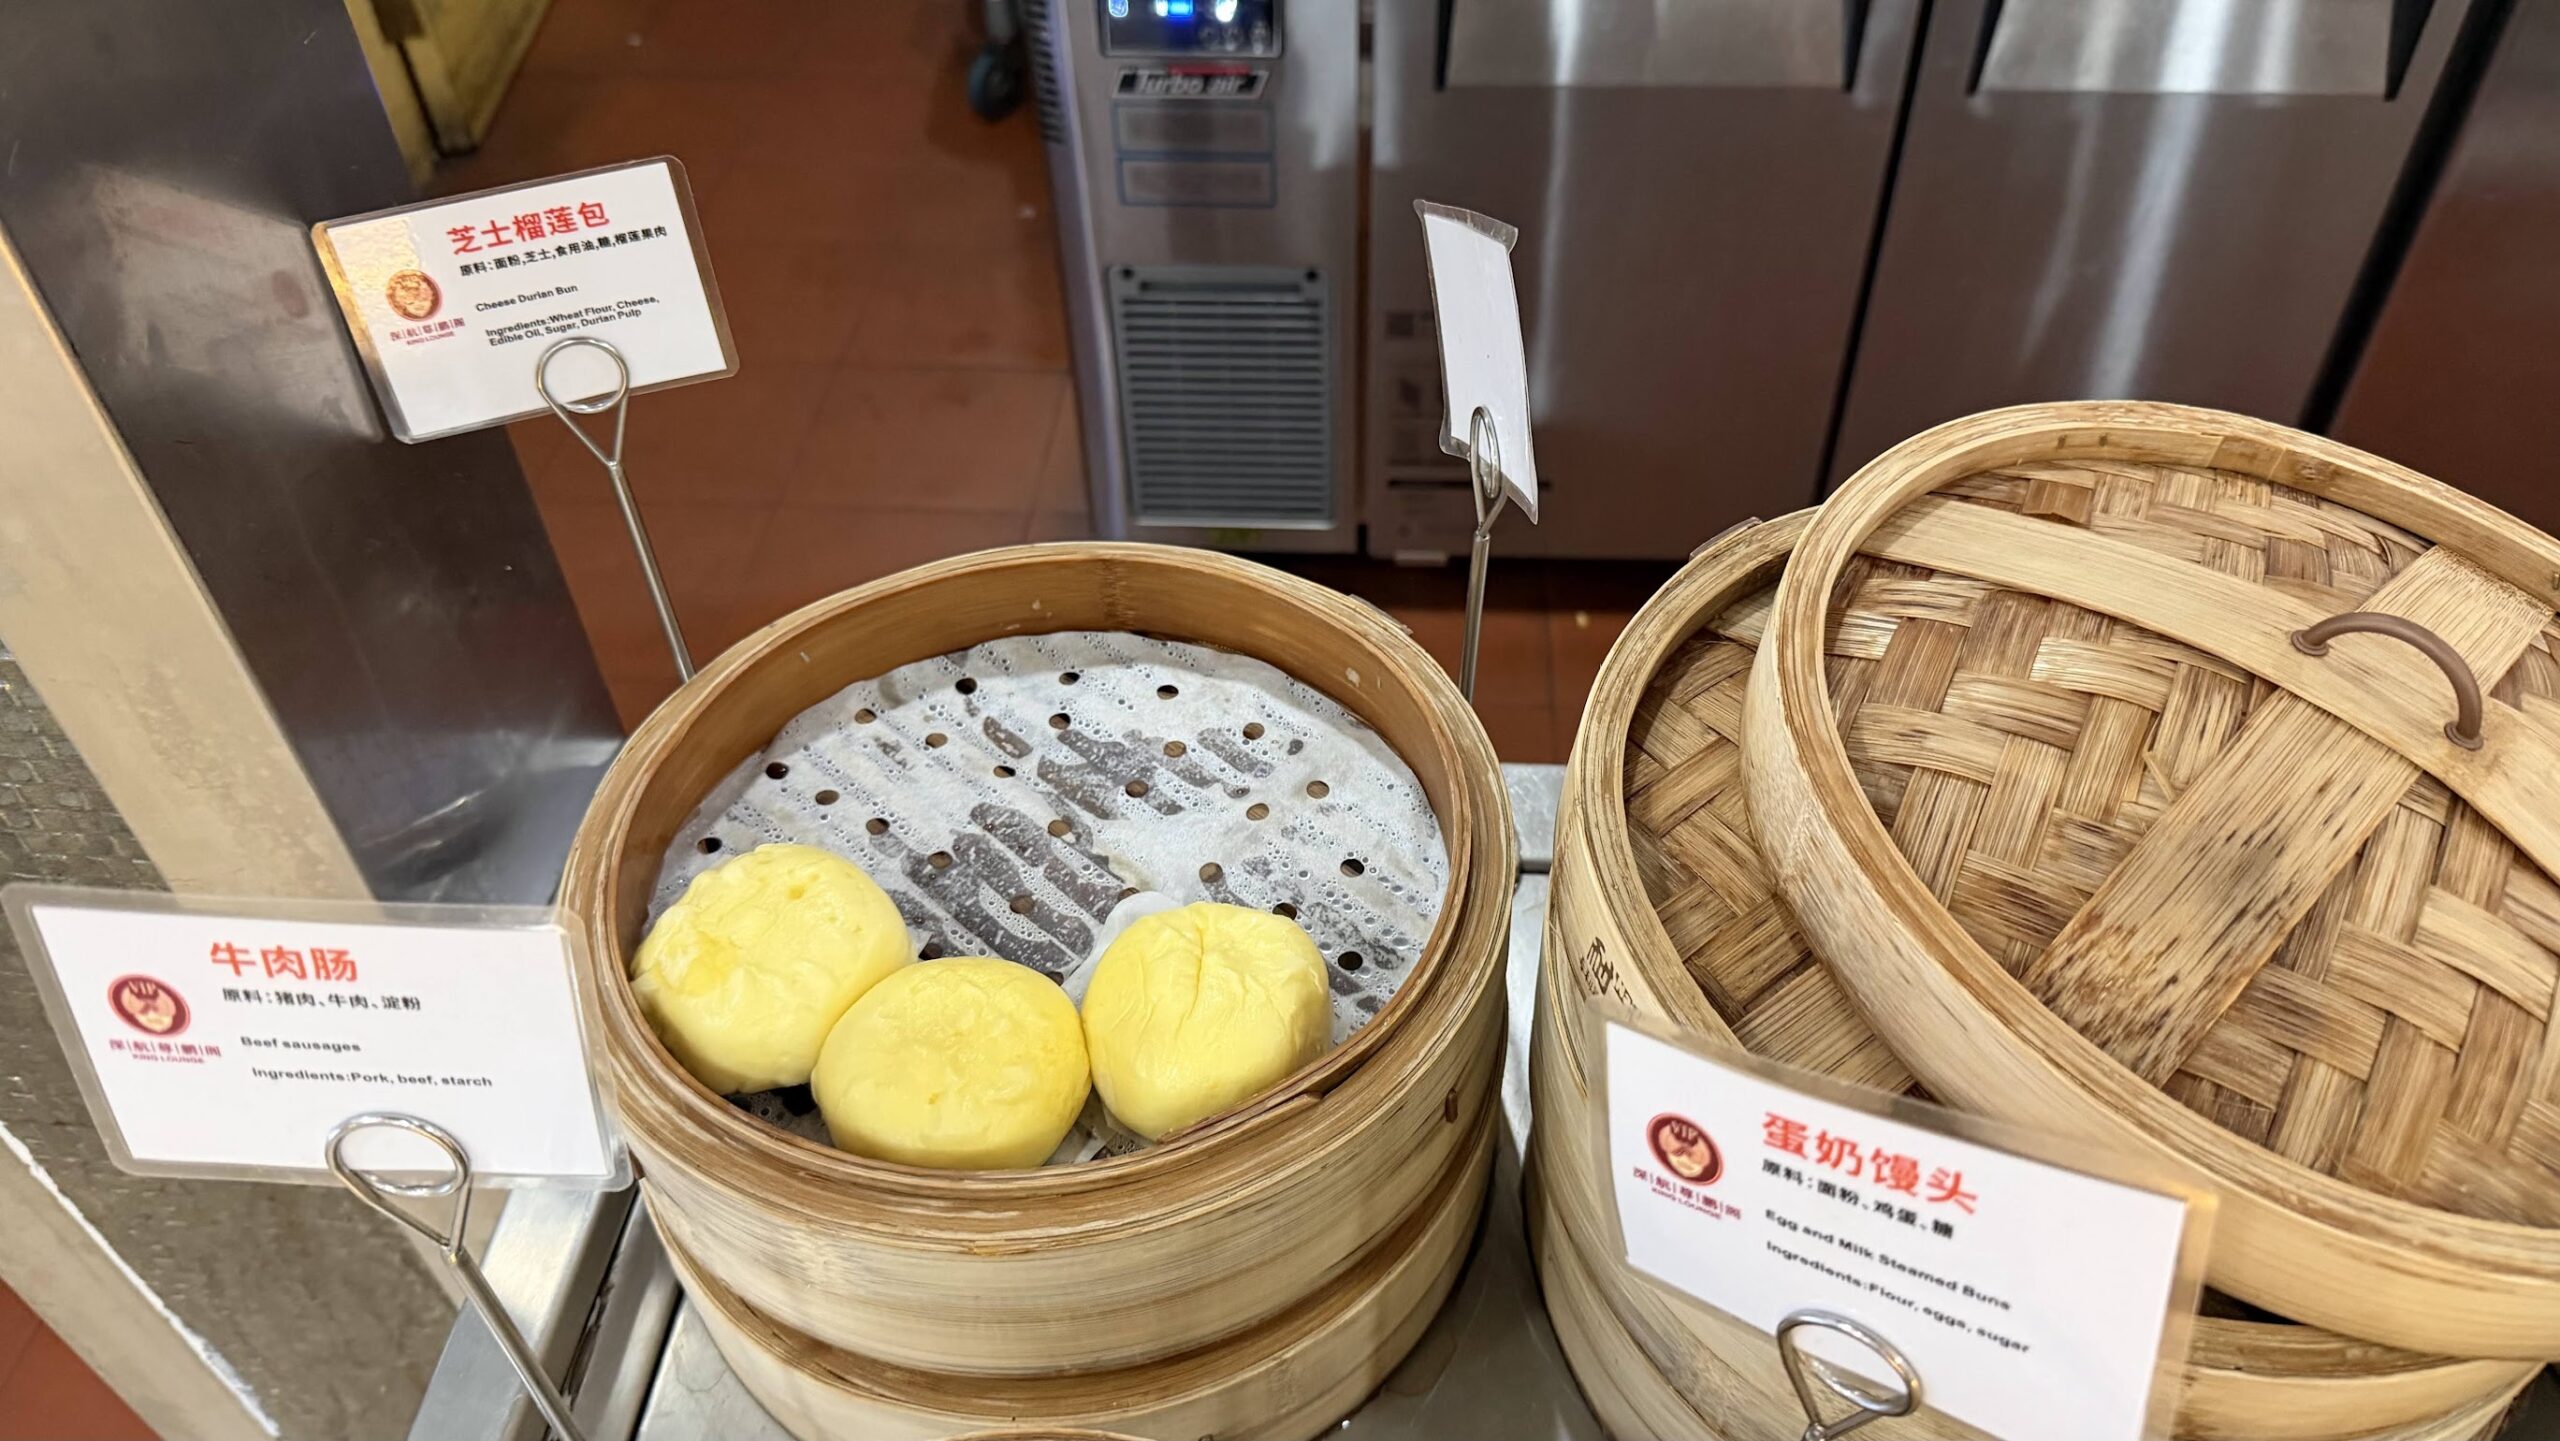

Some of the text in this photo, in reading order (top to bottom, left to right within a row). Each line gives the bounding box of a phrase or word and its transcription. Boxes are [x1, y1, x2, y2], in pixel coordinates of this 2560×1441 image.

[1136, 70, 1203, 94] Turbo
[447, 202, 610, 255] 芝士榴莲包
[475, 284, 578, 312] Cheese Durian Bun
[485, 295, 660, 337] Ingredients:Wheat Flour, Cheese,
[489, 307, 642, 347] Edible Oil, Sugar, Durian Pulp
[210, 941, 358, 982] 牛肉肠
[240, 1036, 361, 1053] Beef sausages
[252, 1066, 492, 1088] Ingredients:Pork, beef, starch
[1671, 1120, 1699, 1141] VIP
[1762, 1112, 1978, 1215] 蛋奶馒头
[1765, 1208, 2011, 1311] Egg and Milk Steamed Buns
[1766, 1240, 2031, 1353] Ingredients:Flour, eggs, sugar
